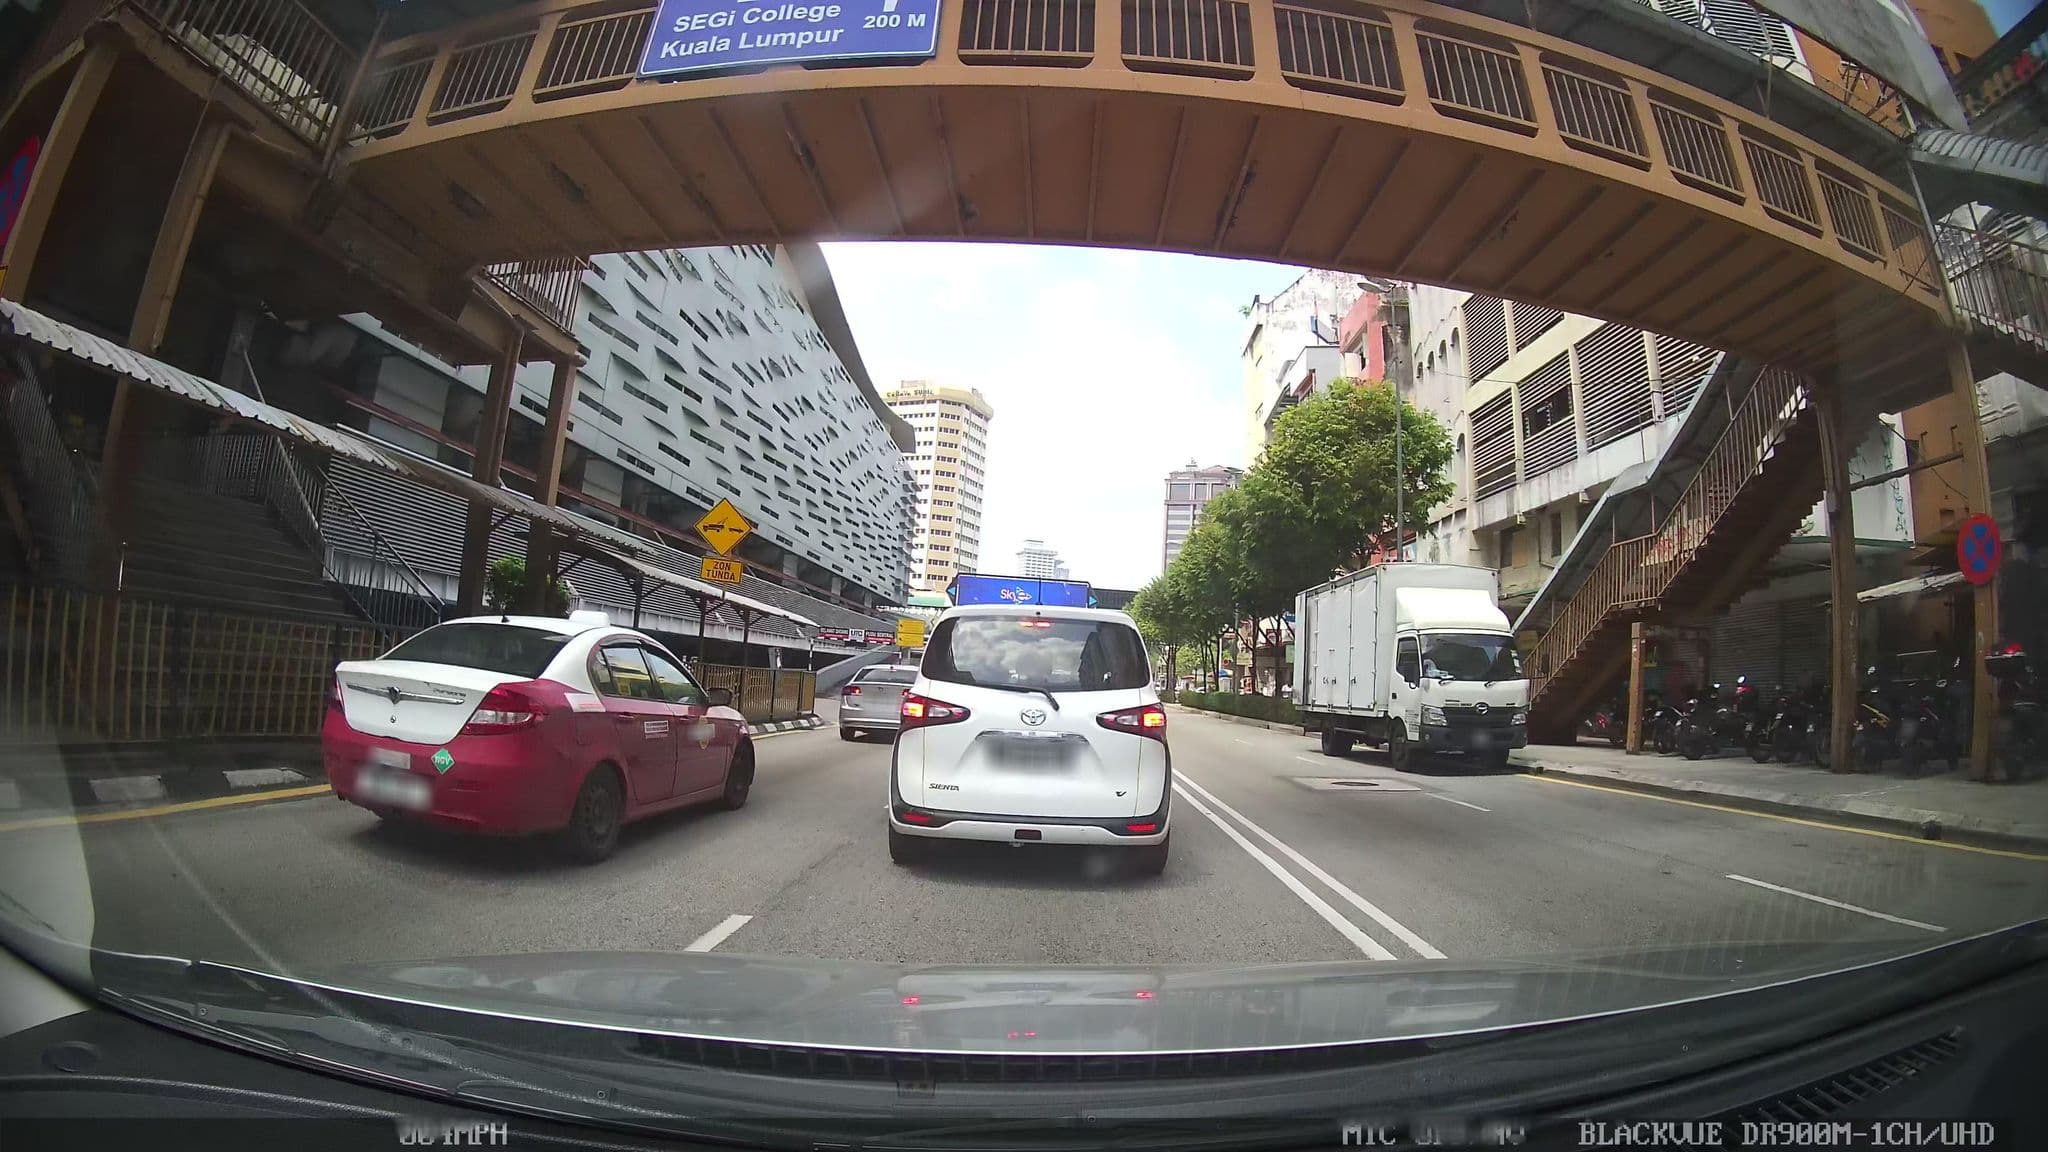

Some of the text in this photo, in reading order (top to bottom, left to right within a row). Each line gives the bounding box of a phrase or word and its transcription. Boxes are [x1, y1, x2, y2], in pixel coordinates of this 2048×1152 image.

[673, 3, 841, 33] SEGi College
[863, 14, 926, 29] 200 M
[660, 27, 845, 59] Kuala Lumpur
[713, 561, 731, 570] ZON
[706, 569, 735, 580] TUNDA
[928, 783, 960, 791] SIENTA
